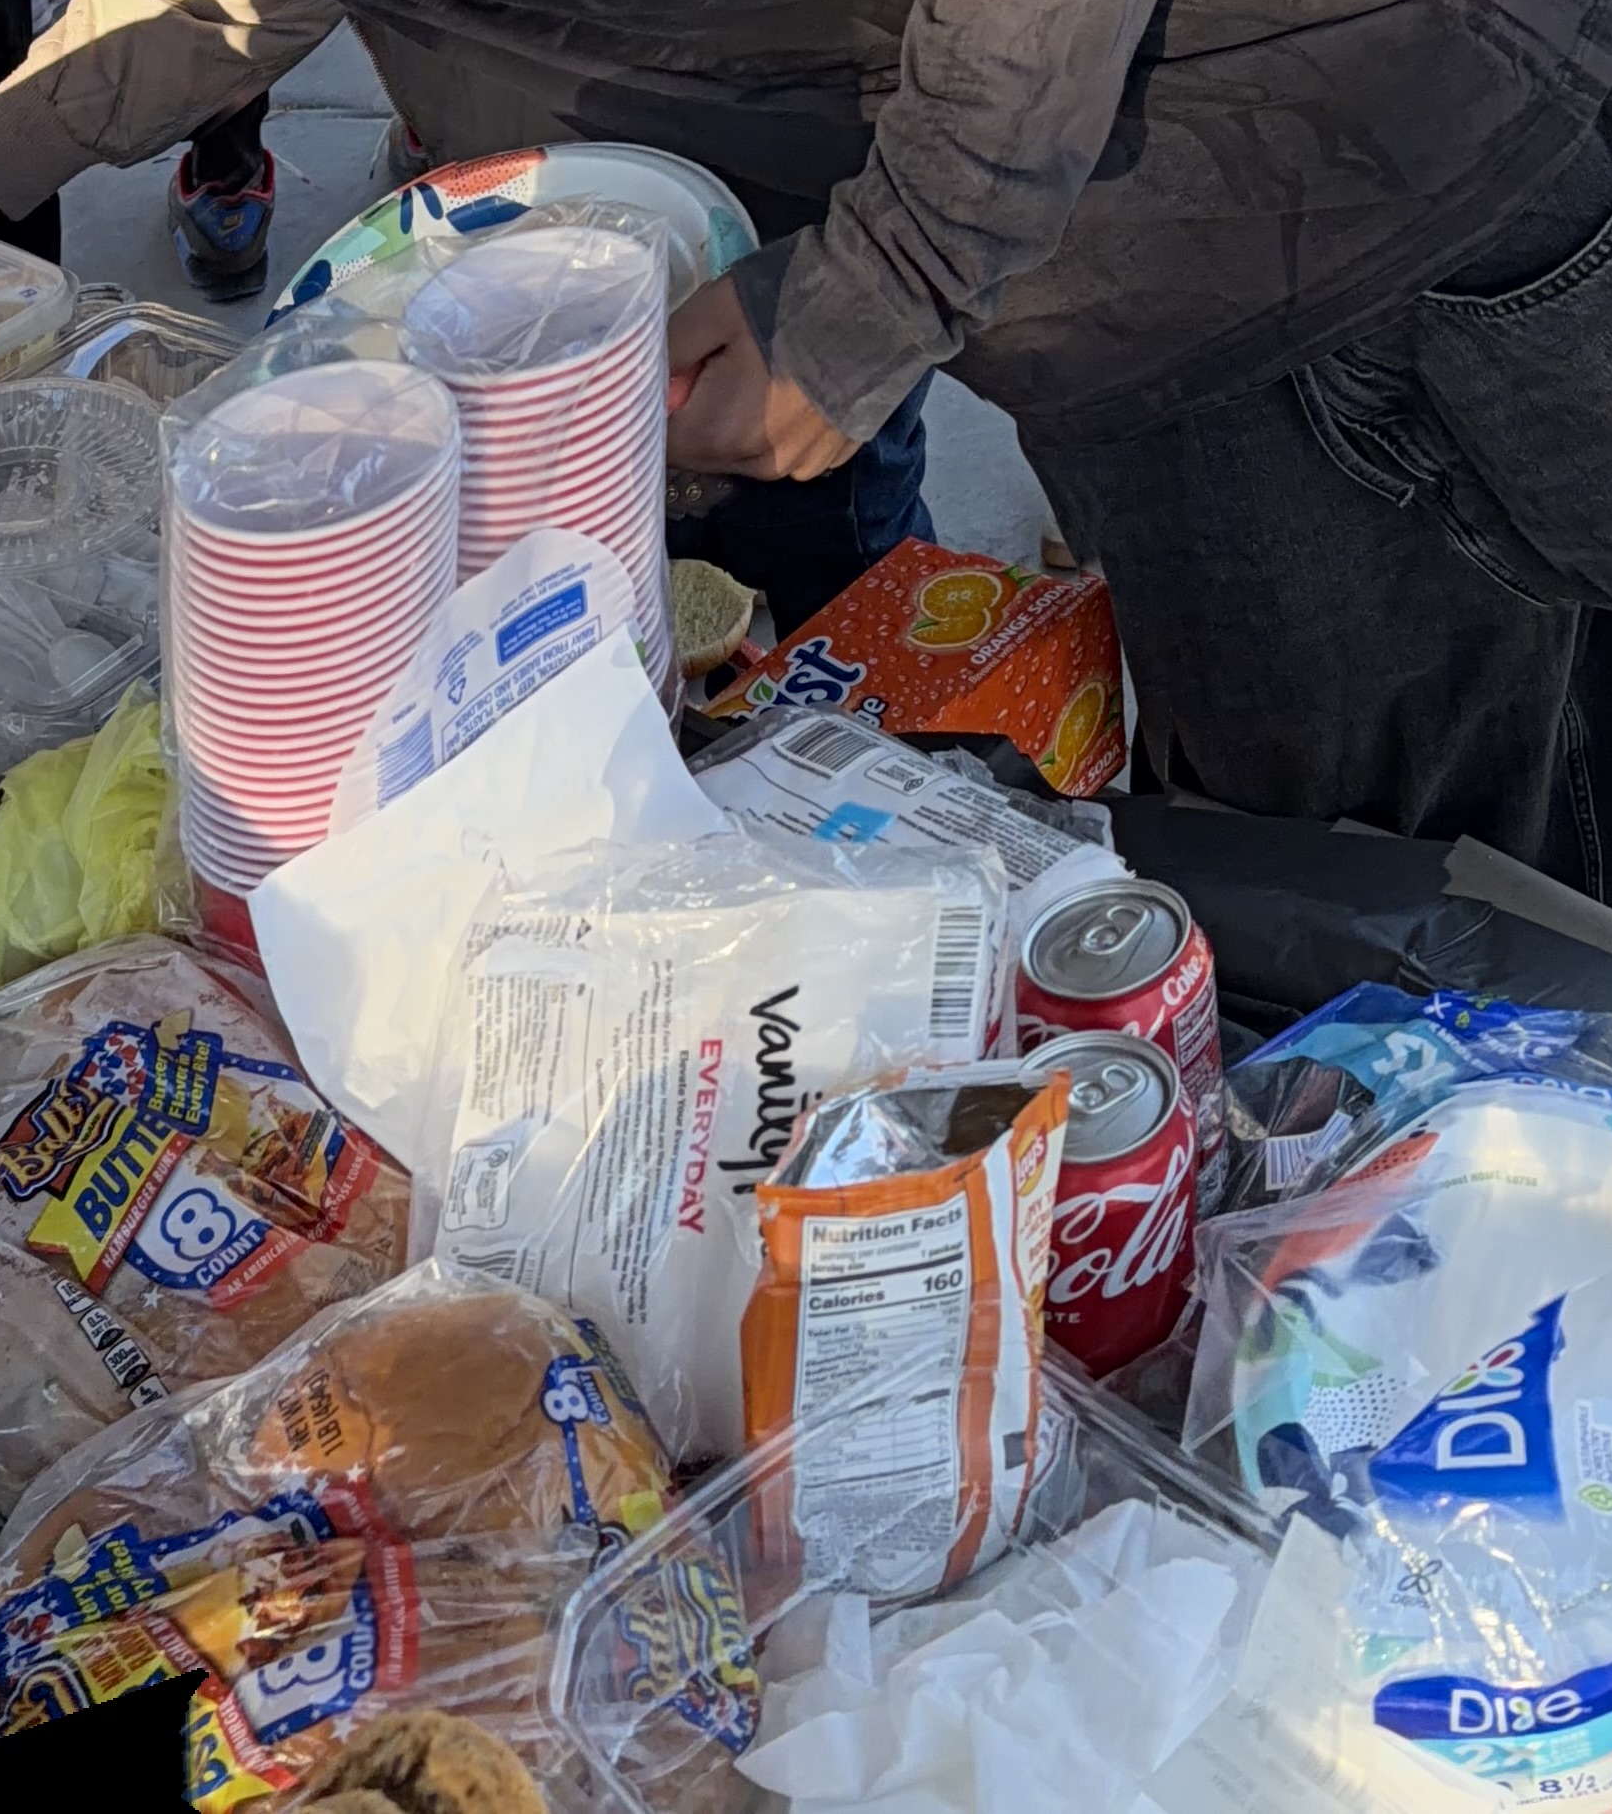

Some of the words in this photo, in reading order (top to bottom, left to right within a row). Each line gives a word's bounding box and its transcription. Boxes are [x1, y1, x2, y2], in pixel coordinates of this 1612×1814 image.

[569, 625, 596, 648] AWAY
[970, 612, 1034, 665] ORANGE
[1029, 584, 1073, 615] SODA
[512, 657, 542, 684] BABIES
[542, 641, 569, 664] FROM
[494, 678, 511, 697] AND
[495, 692, 514, 710] THIS
[514, 674, 536, 696] KEEP
[454, 692, 492, 729] CHILDREN
[461, 705, 494, 738] PLASTIC
[445, 732, 460, 751] BAG
[676, 1050, 689, 1095] Elevate
[718, 985, 822, 1171] Vanity
[675, 1098, 687, 1128] Your
[678, 1038, 724, 1235] EVERYDAY
[1014, 1133, 1046, 1185] Lay's
[102, 1181, 156, 1269] HAMBURGER
[154, 1149, 179, 1187] BUNS
[161, 1188, 236, 1262] 8
[812, 1220, 904, 1244] Nutrition
[911, 1208, 963, 1232] Facts
[195, 1224, 263, 1287] COUNT
[228, 1280, 244, 1296] AN
[809, 1289, 885, 1311] Calories
[923, 1269, 963, 1293] 160
[543, 1382, 590, 1424] 8
[577, 1370, 611, 1424] COUNT
[1539, 1779, 1562, 1794] 8
